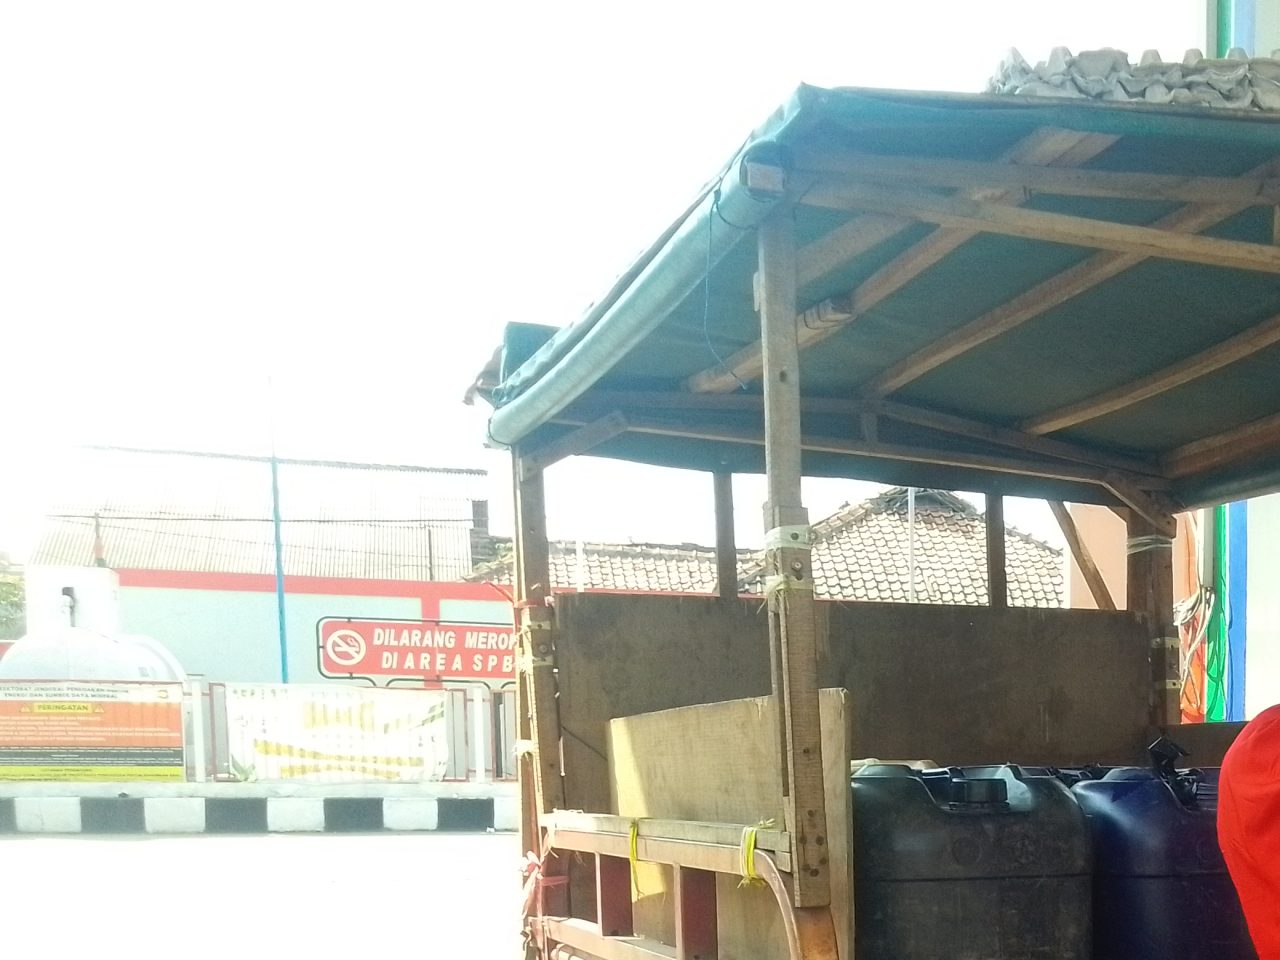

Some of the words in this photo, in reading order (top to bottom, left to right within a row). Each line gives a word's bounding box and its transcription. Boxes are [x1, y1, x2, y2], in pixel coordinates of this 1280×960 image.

[373, 627, 456, 648] DILARANG
[381, 652, 398, 669] DI
[404, 652, 463, 671] AREA
